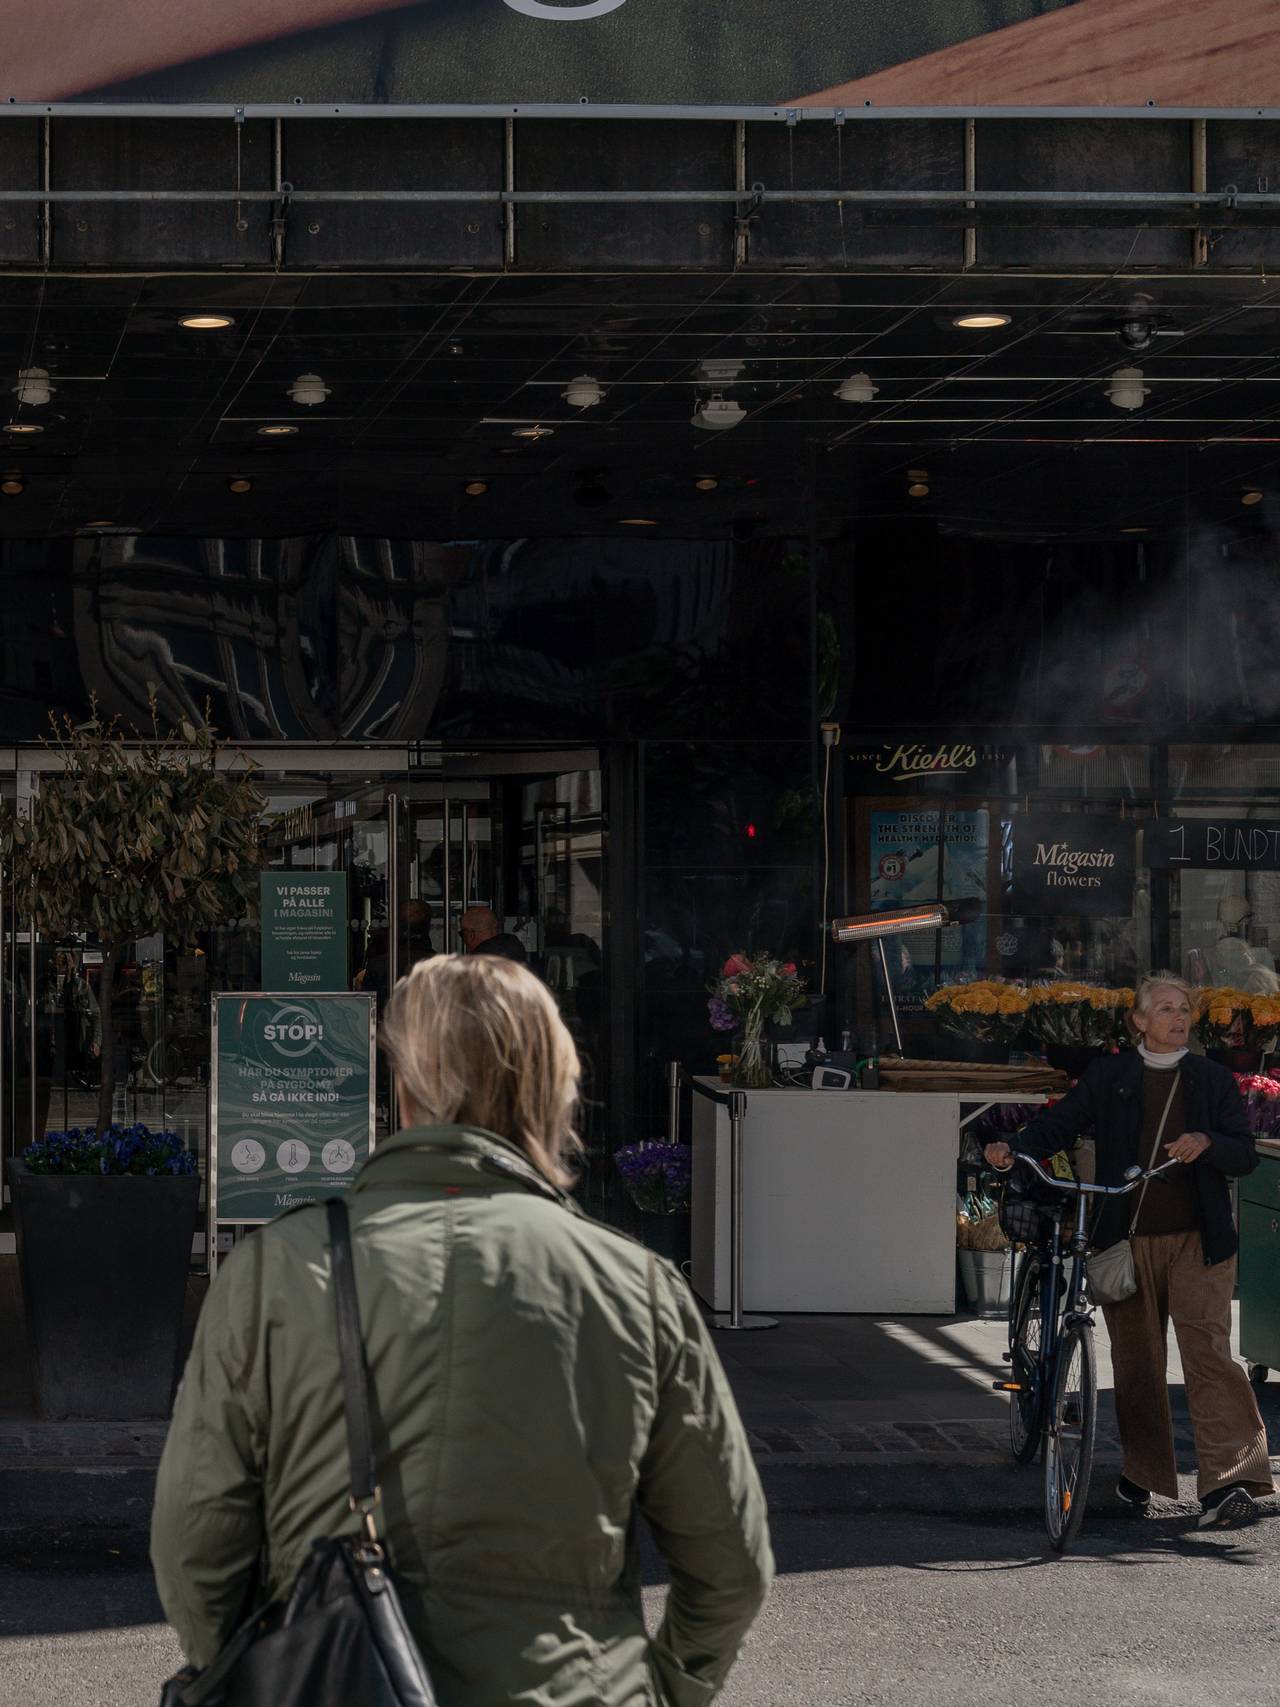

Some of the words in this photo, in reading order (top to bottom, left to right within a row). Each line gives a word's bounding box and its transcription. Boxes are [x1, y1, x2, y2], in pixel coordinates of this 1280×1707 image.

[875, 744, 977, 772] Kiehl's
[878, 824, 899, 833] THE
[902, 824, 959, 833] STRENTH
[1169, 824, 1191, 861] 1
[1032, 841, 1116, 874] Magasin
[1046, 871, 1102, 888] flowers
[276, 886, 288, 896] VI
[290, 886, 331, 896] PASSER
[282, 896, 297, 908] PÅ
[298, 898, 325, 908] ALLE
[279, 908, 334, 918] MAGASIN!
[287, 972, 321, 984] Magasin
[263, 1024, 324, 1041] STOP!
[238, 1067, 264, 1077] HAR
[264, 1067, 280, 1077] DU
[282, 1067, 353, 1077] SYMPTOMER
[276, 1080, 331, 1090] SYGDOM?
[252, 1090, 269, 1102] SÅ
[269, 1090, 287, 1102] GÅ
[287, 1092, 314, 1102] IKKE
[315, 1092, 340, 1102] IND!
